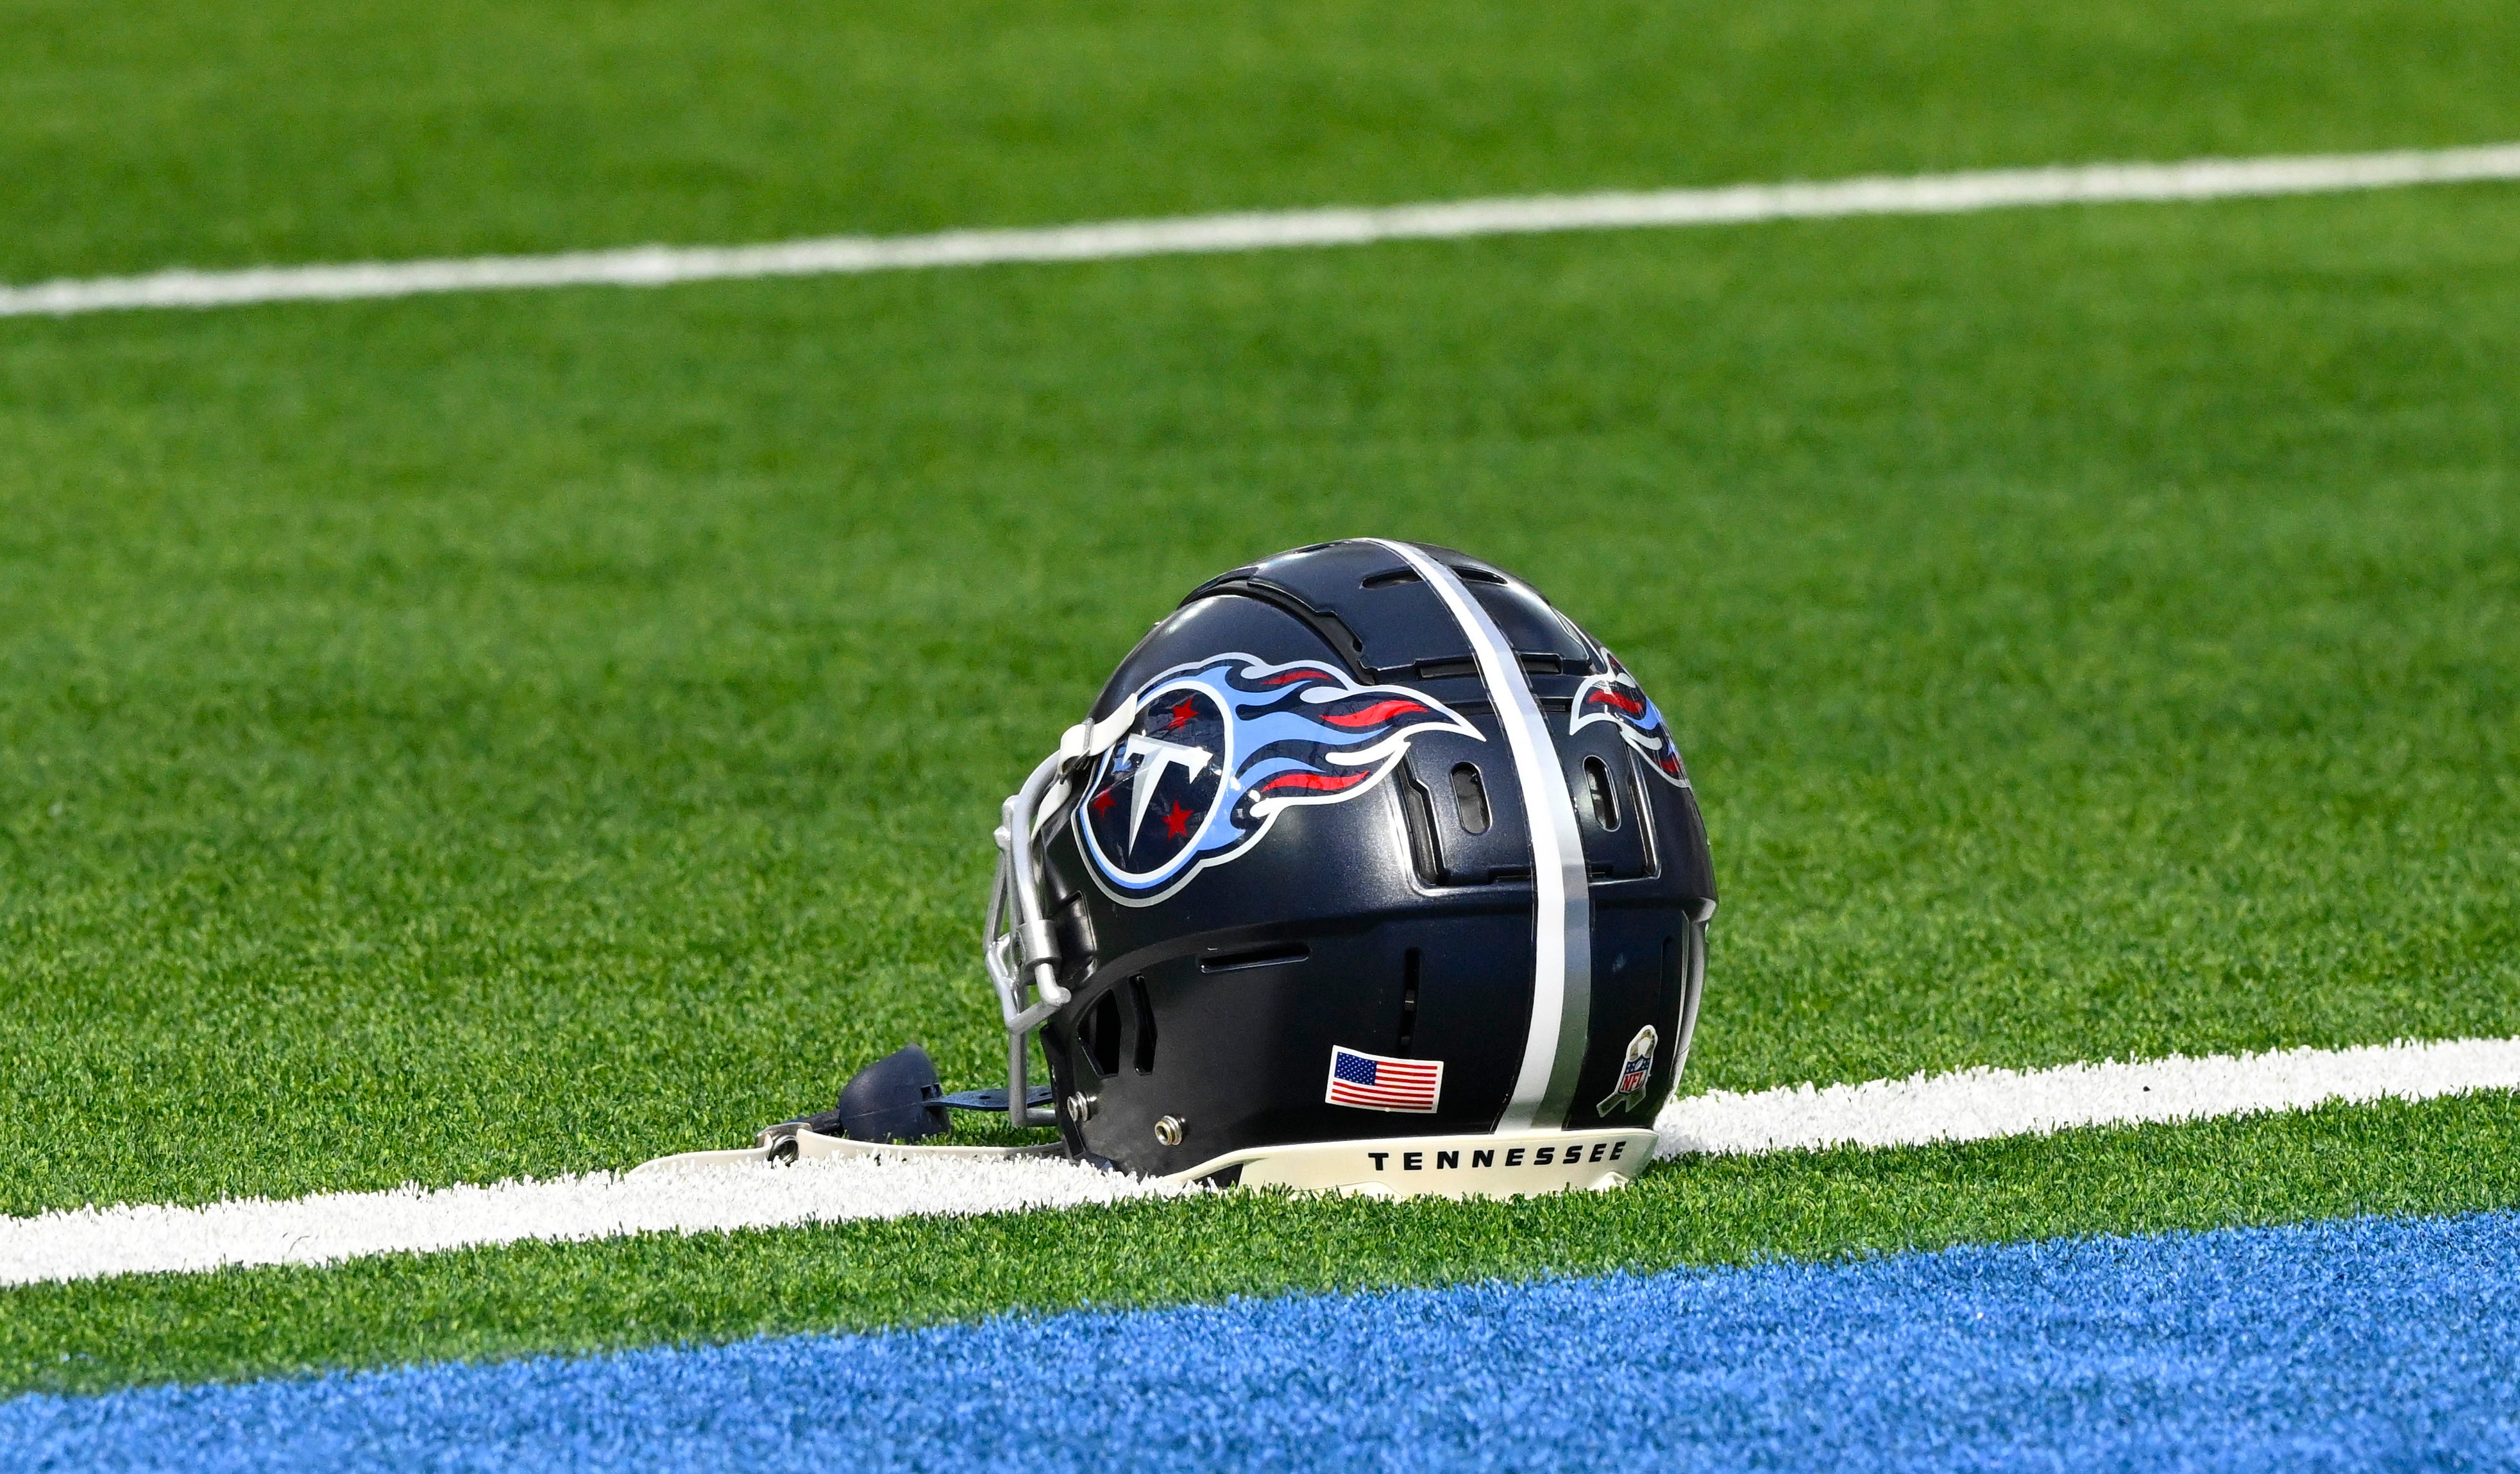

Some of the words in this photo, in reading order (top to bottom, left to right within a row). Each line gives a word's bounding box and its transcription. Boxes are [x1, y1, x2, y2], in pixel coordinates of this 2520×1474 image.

[1122, 733, 1213, 858] T
[1620, 1072, 1644, 1092] NFL
[1367, 1141, 1627, 1171] TENNESSEE
